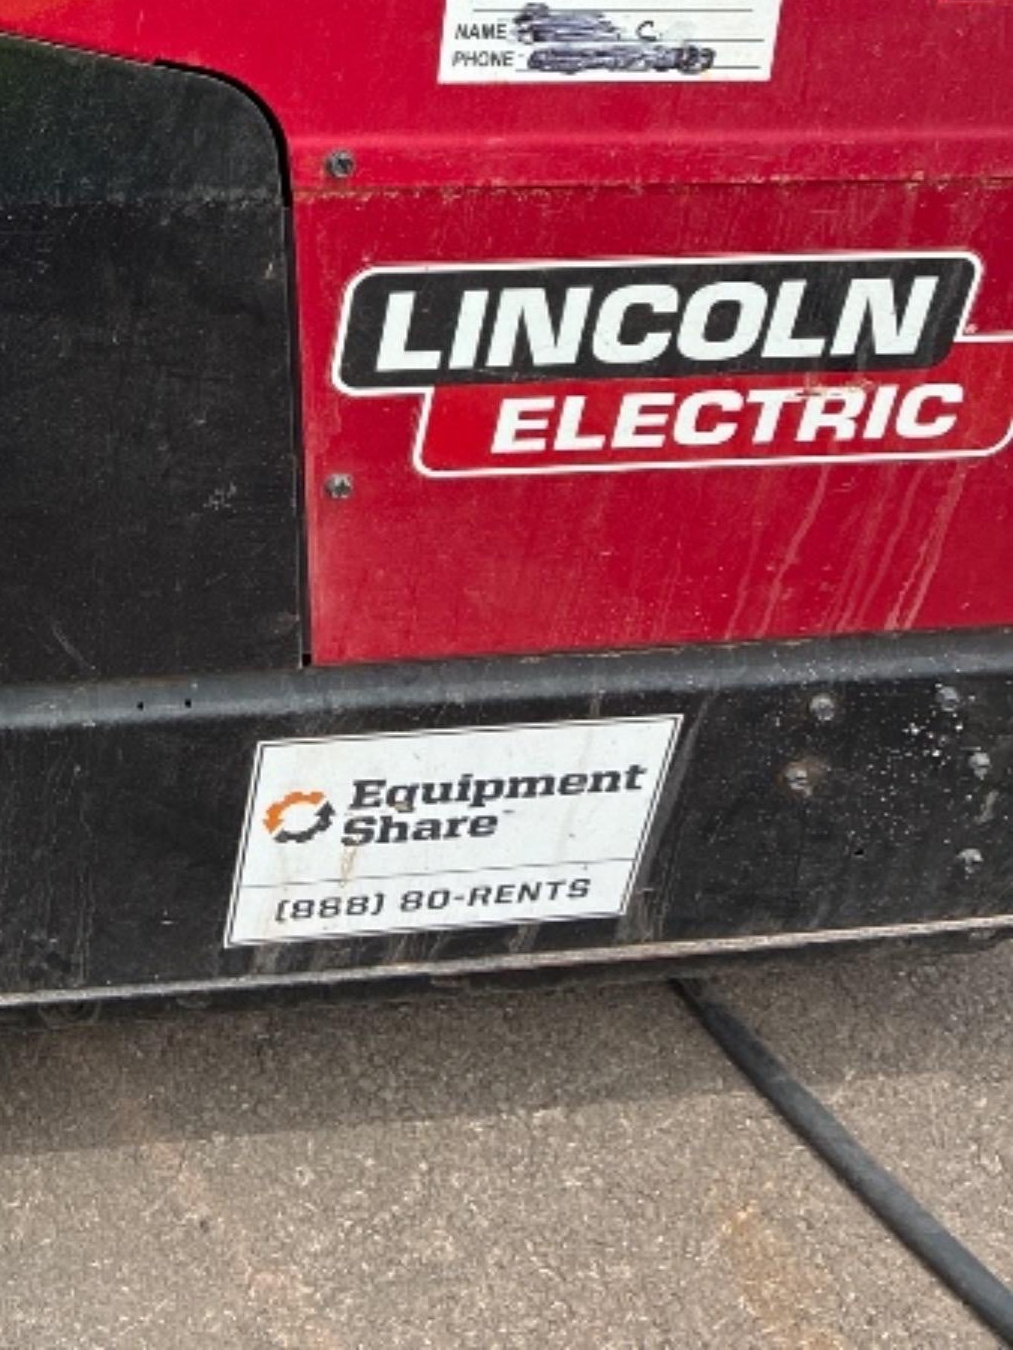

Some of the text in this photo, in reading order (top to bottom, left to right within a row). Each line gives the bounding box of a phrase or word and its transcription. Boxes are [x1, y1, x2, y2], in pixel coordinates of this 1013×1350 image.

[454, 22, 508, 41] NAME
[451, 50, 515, 68] PHONE
[374, 274, 940, 373] LINCOLN
[490, 382, 964, 454] ELECTRIC
[348, 763, 648, 813] Equipment
[340, 813, 499, 847] Share
[274, 877, 592, 923] (888) 80-RENTS
